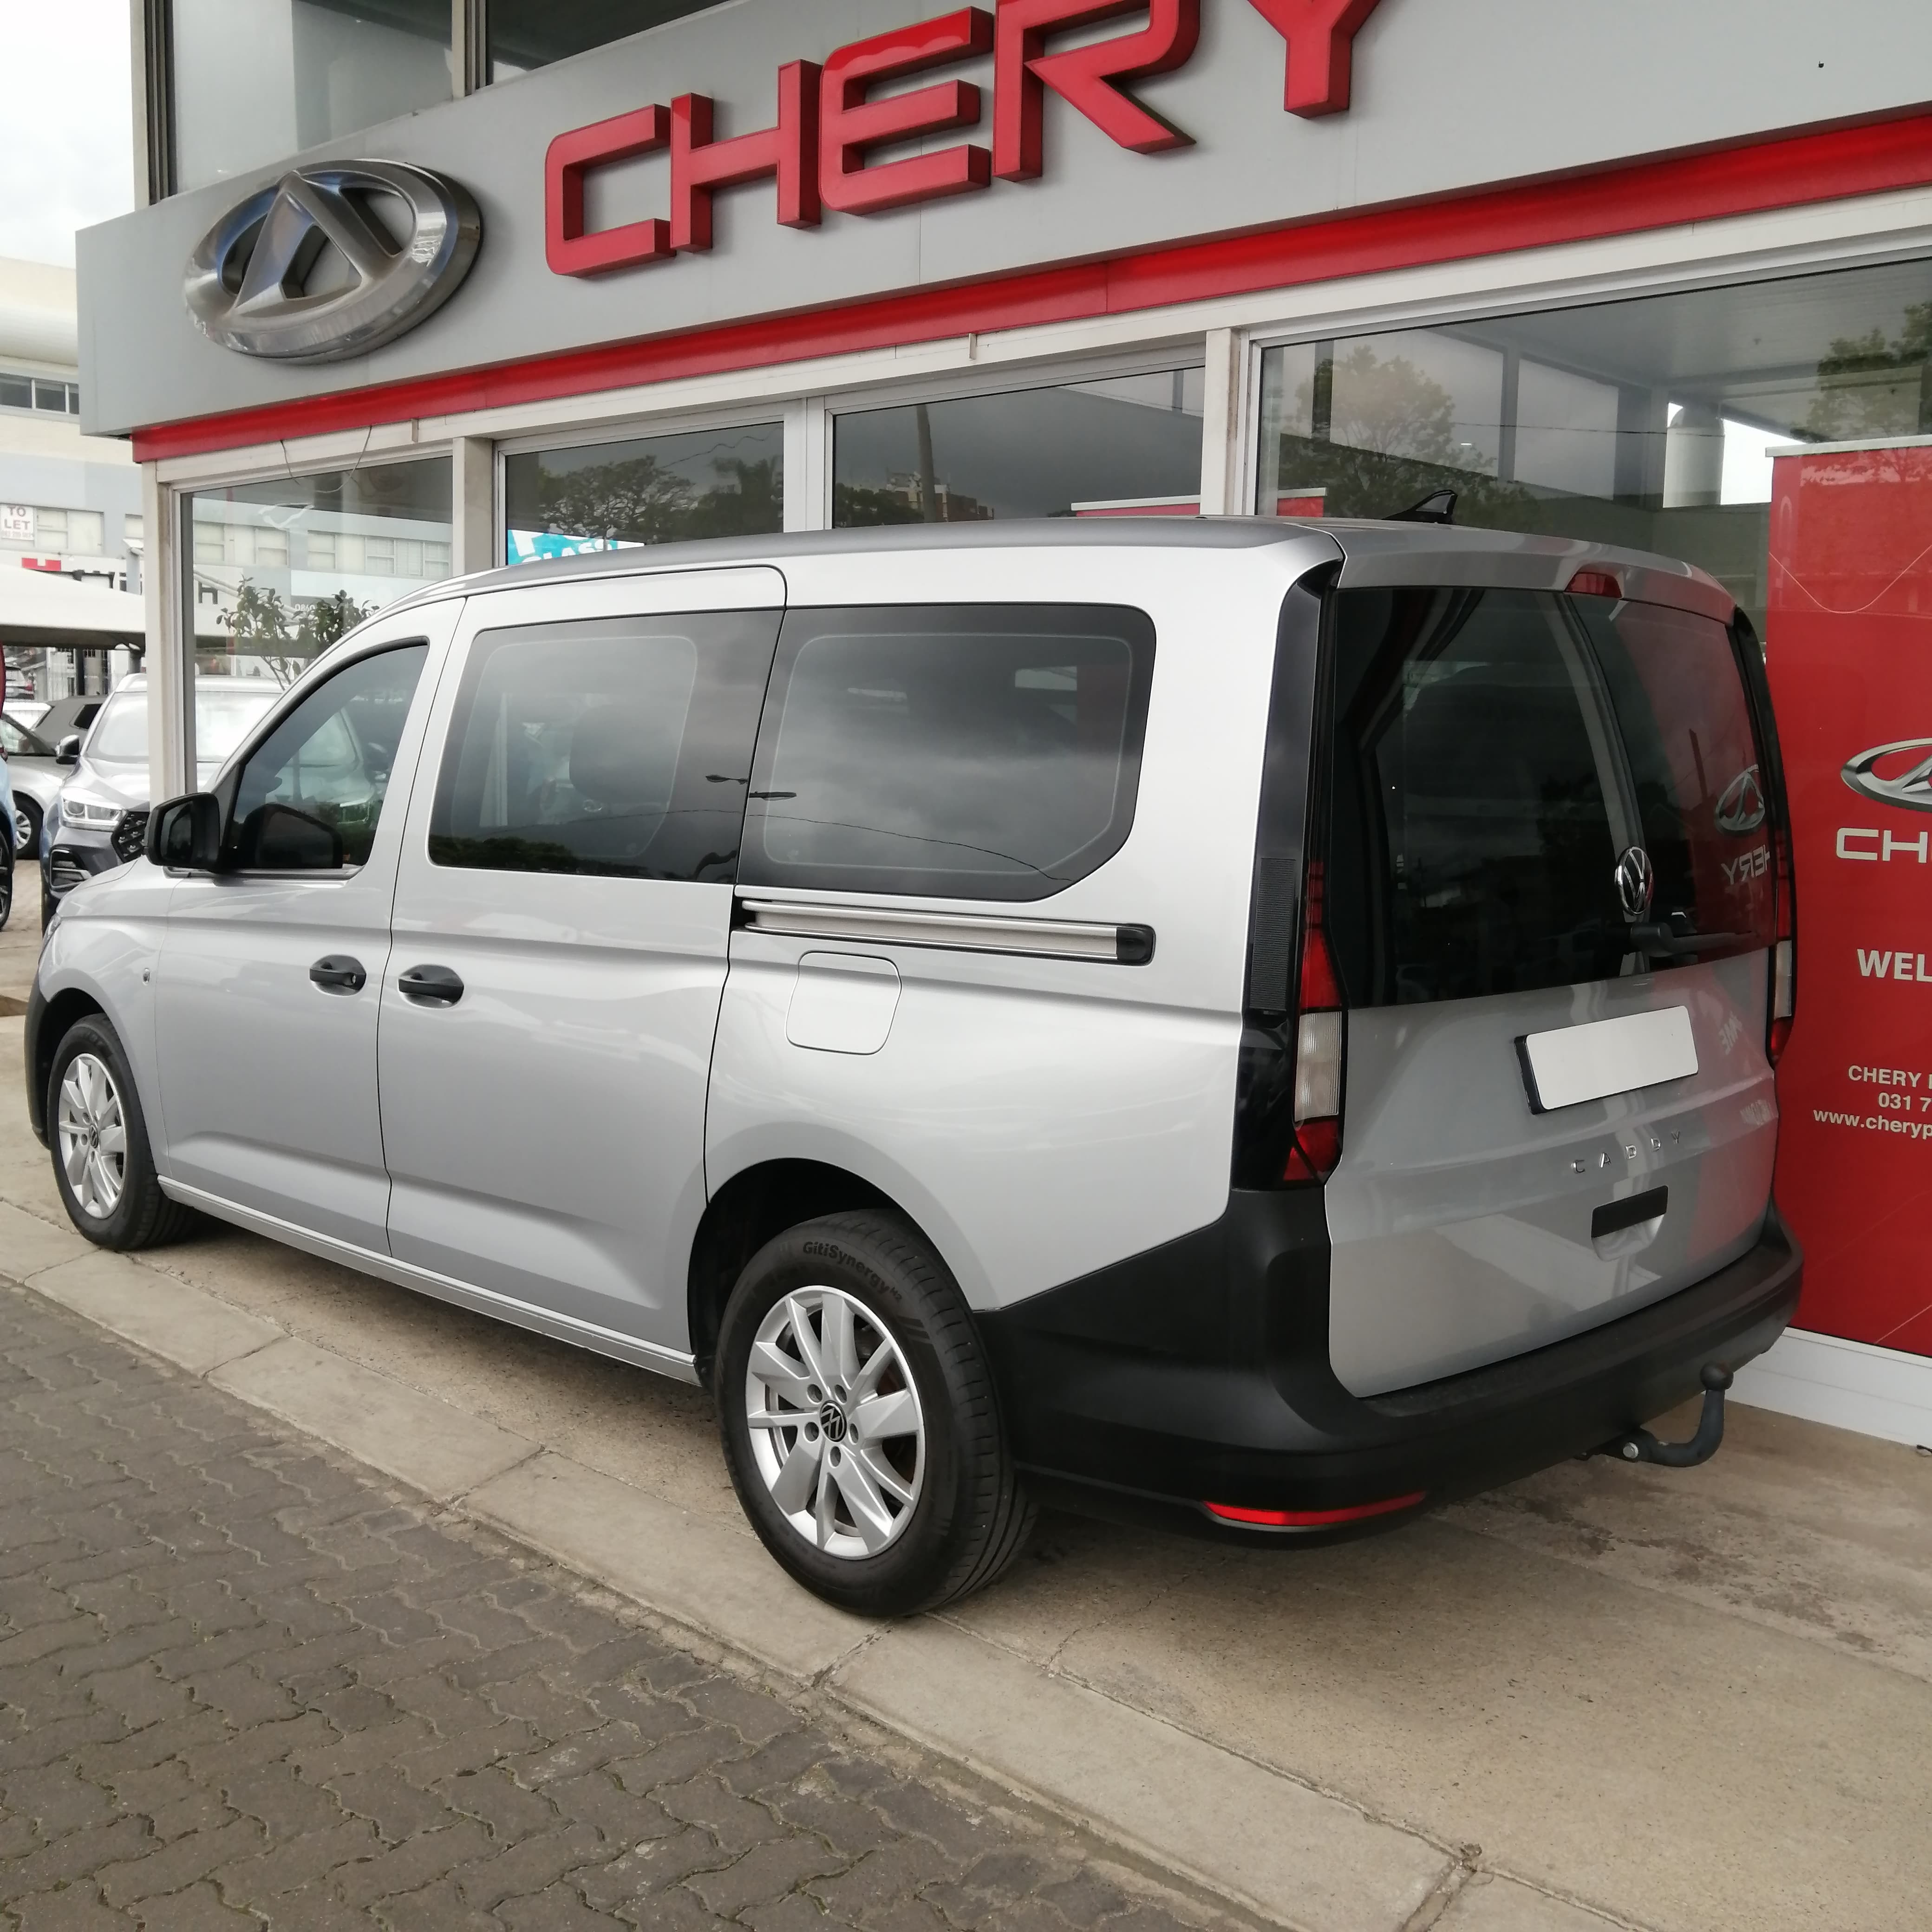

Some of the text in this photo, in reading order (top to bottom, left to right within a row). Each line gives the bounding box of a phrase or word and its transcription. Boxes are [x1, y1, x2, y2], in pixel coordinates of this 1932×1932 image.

[544, 0, 1380, 277] CHERY
[4, 519, 30, 530] LET
[7, 505, 26, 517] TO
[1836, 828, 1932, 863] CH
[1857, 949, 1932, 982] WEL
[1848, 1065, 1922, 1088] CHERY
[1879, 1092, 1911, 1110] 031
[1813, 1110, 1932, 1140] www.cheryp
[1571, 1130, 1680, 1174] CADDY
